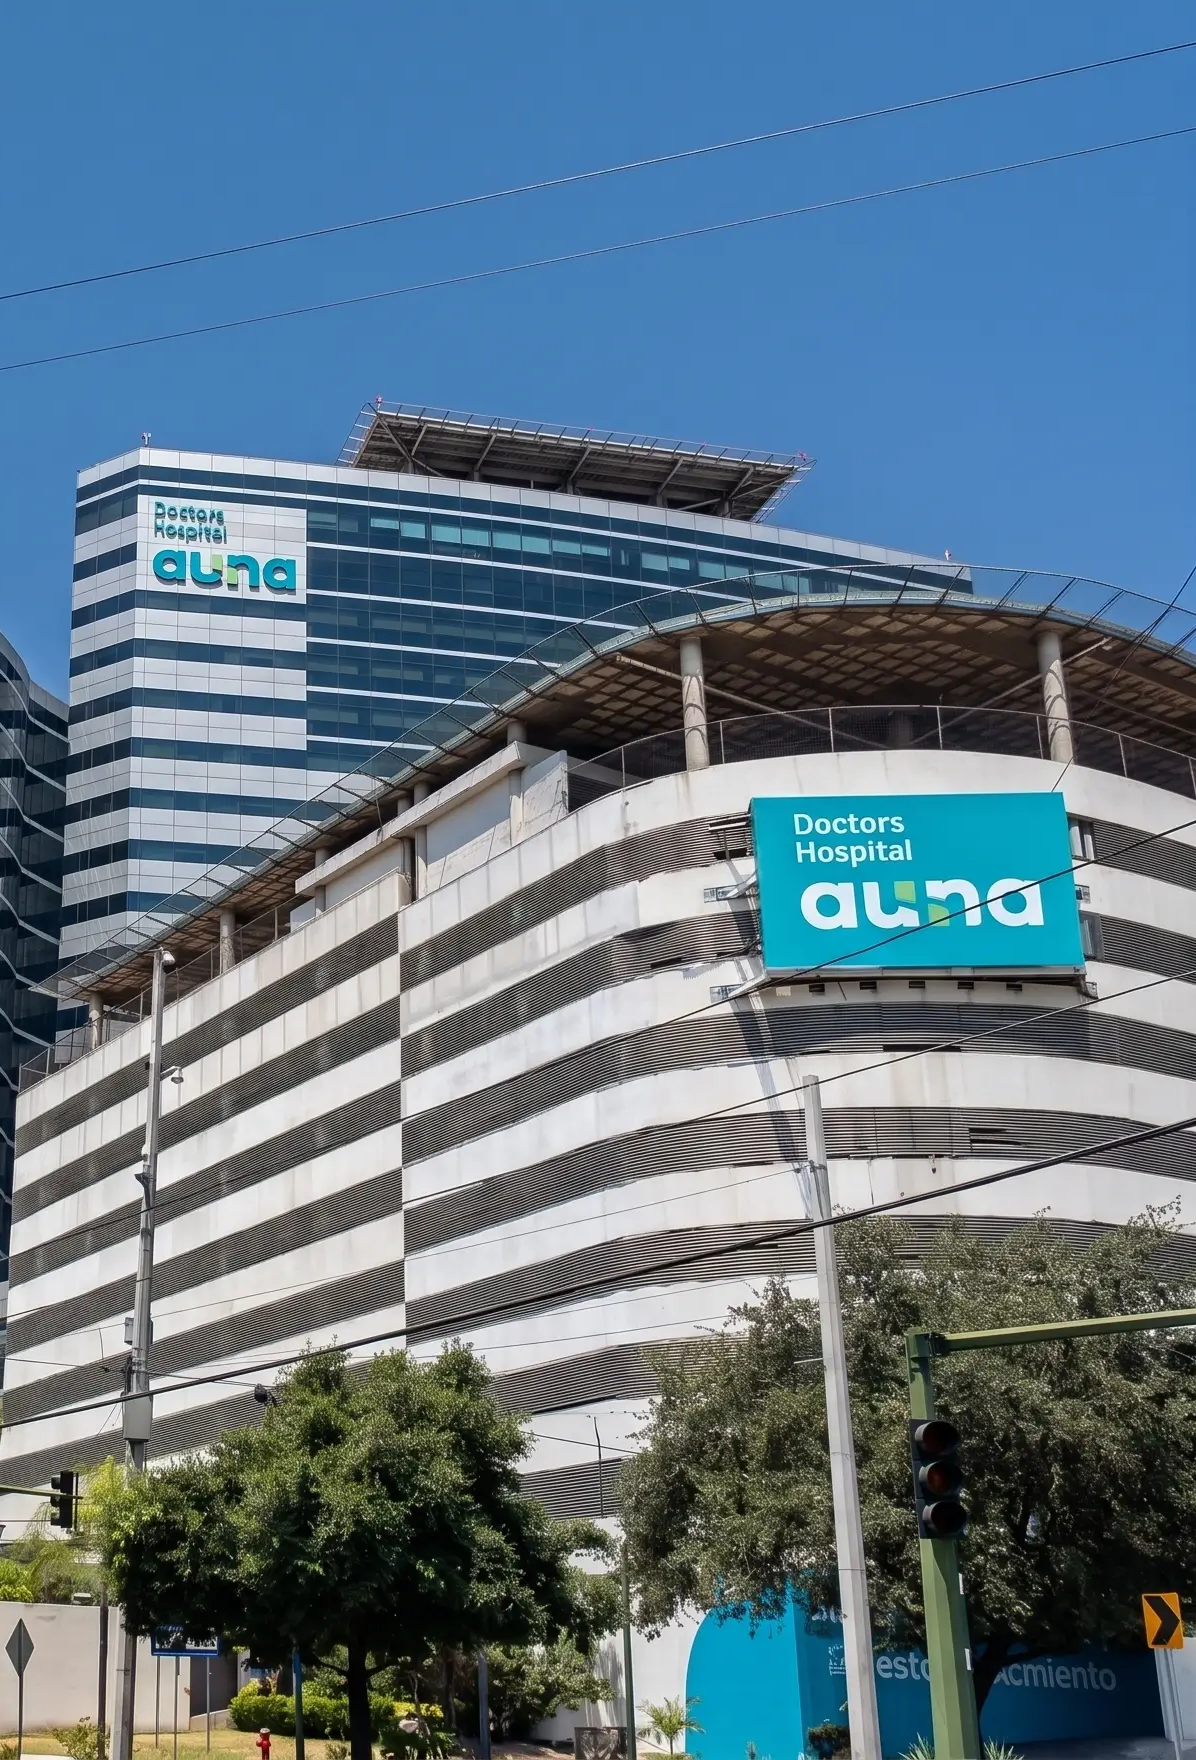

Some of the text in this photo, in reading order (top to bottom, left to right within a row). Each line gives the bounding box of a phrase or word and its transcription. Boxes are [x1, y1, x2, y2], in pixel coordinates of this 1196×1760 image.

[154, 501, 225, 525] Doctors
[154, 519, 228, 544] Hospital
[153, 549, 297, 590] auna
[793, 813, 905, 835] Doctors
[795, 839, 913, 867] Hospital
[800, 877, 1045, 930] auna
